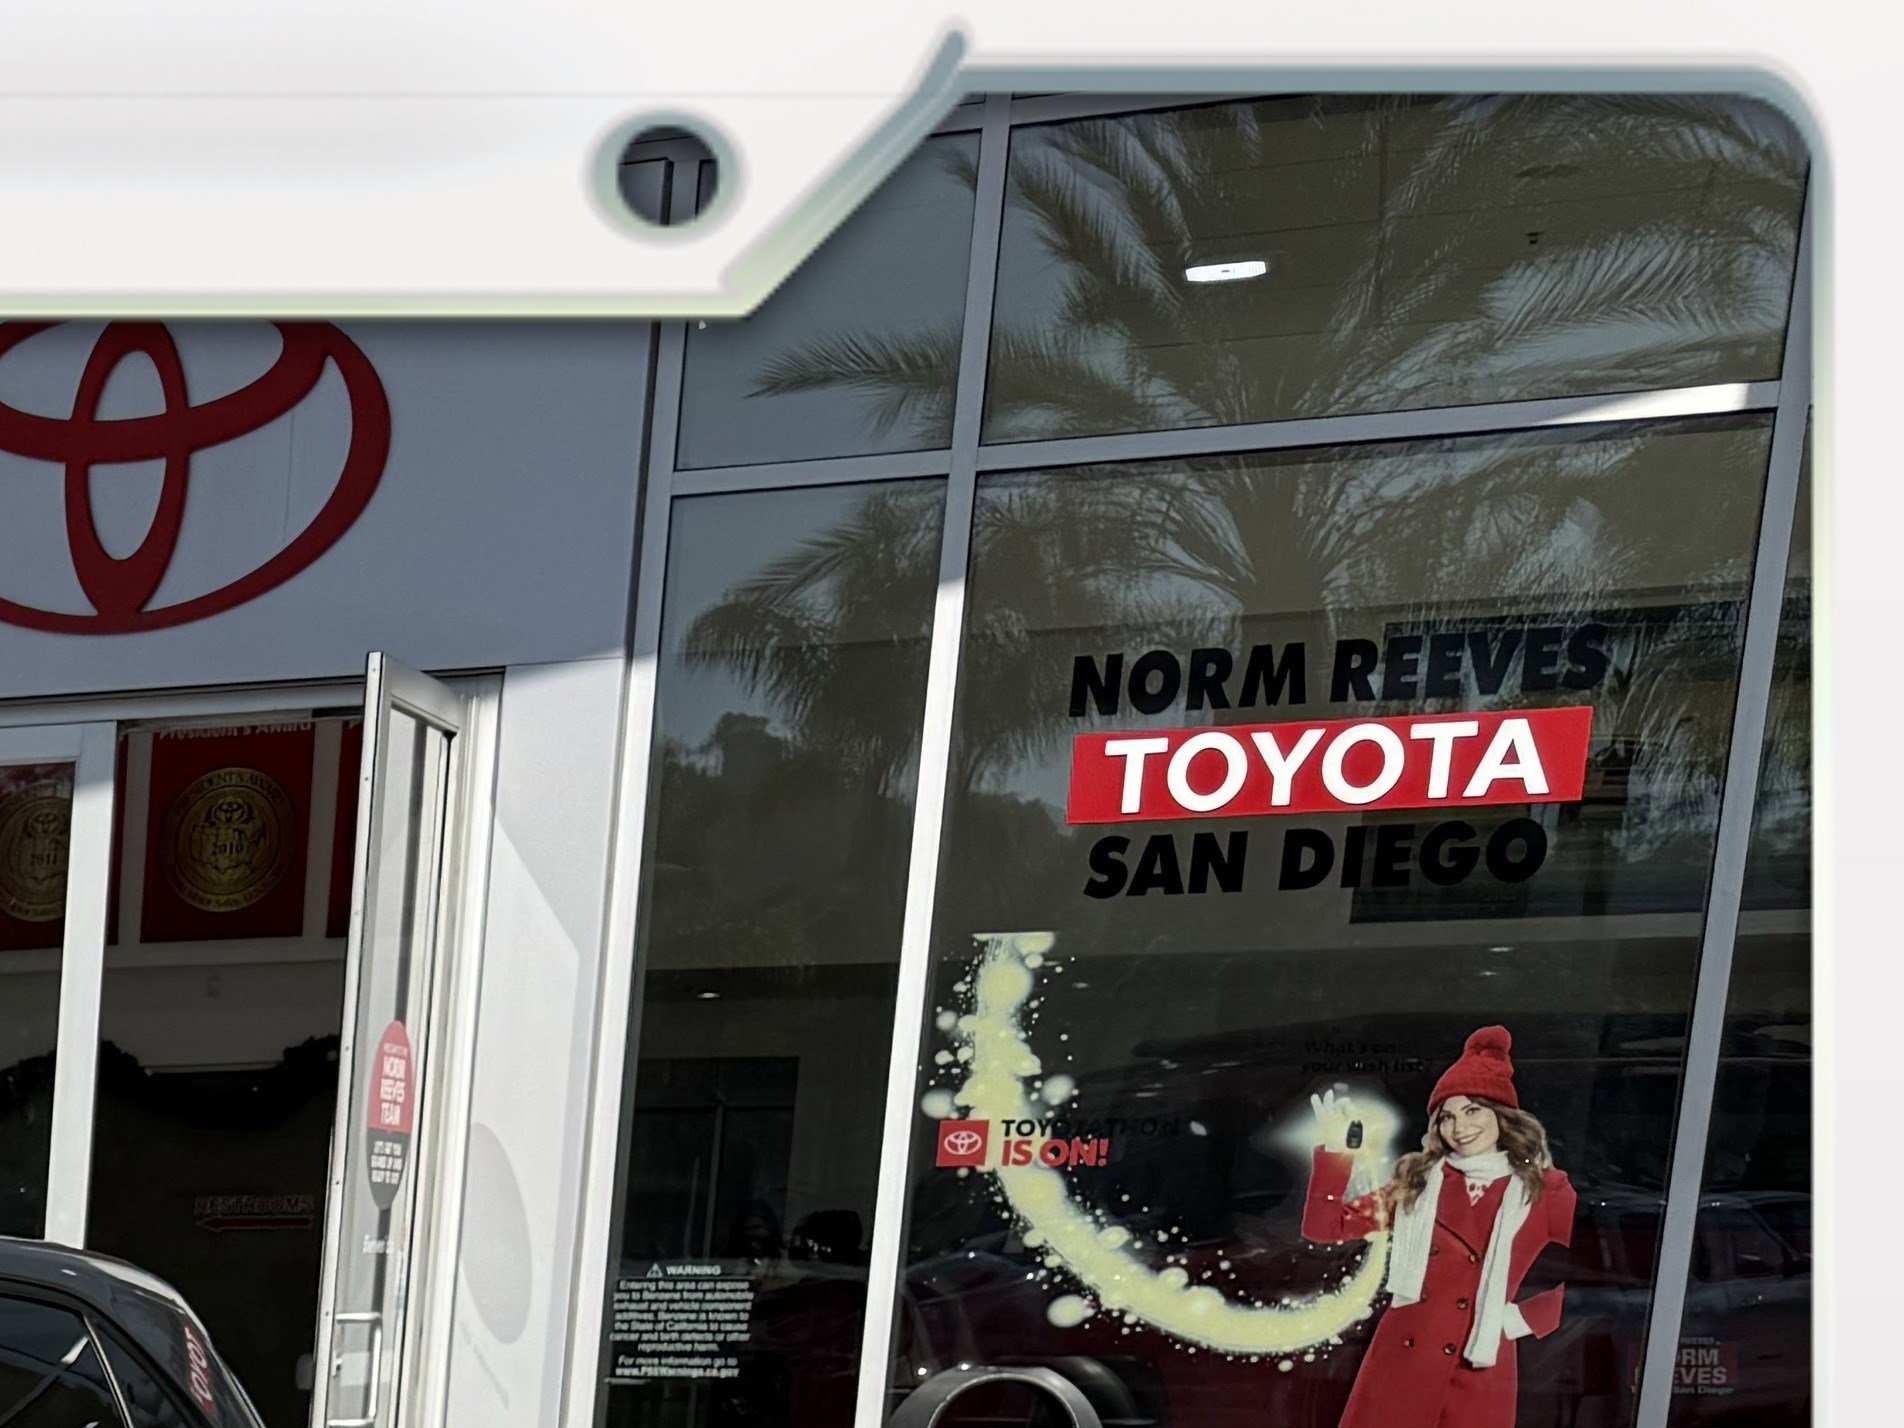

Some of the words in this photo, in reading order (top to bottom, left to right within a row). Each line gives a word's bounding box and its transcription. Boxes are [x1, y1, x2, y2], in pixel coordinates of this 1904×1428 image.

[1069, 641, 1308, 718] NORM
[1330, 622, 1610, 704] REEVES
[1103, 717, 1551, 815] TOYOTA
[1082, 830, 1249, 899] SAN
[1278, 818, 1548, 891] DIEGO
[1001, 1138, 1034, 1167] IS
[1039, 1137, 1112, 1167] ON!
[666, 1265, 722, 1276] WARNING
[1676, 1348, 1719, 1366] RM
